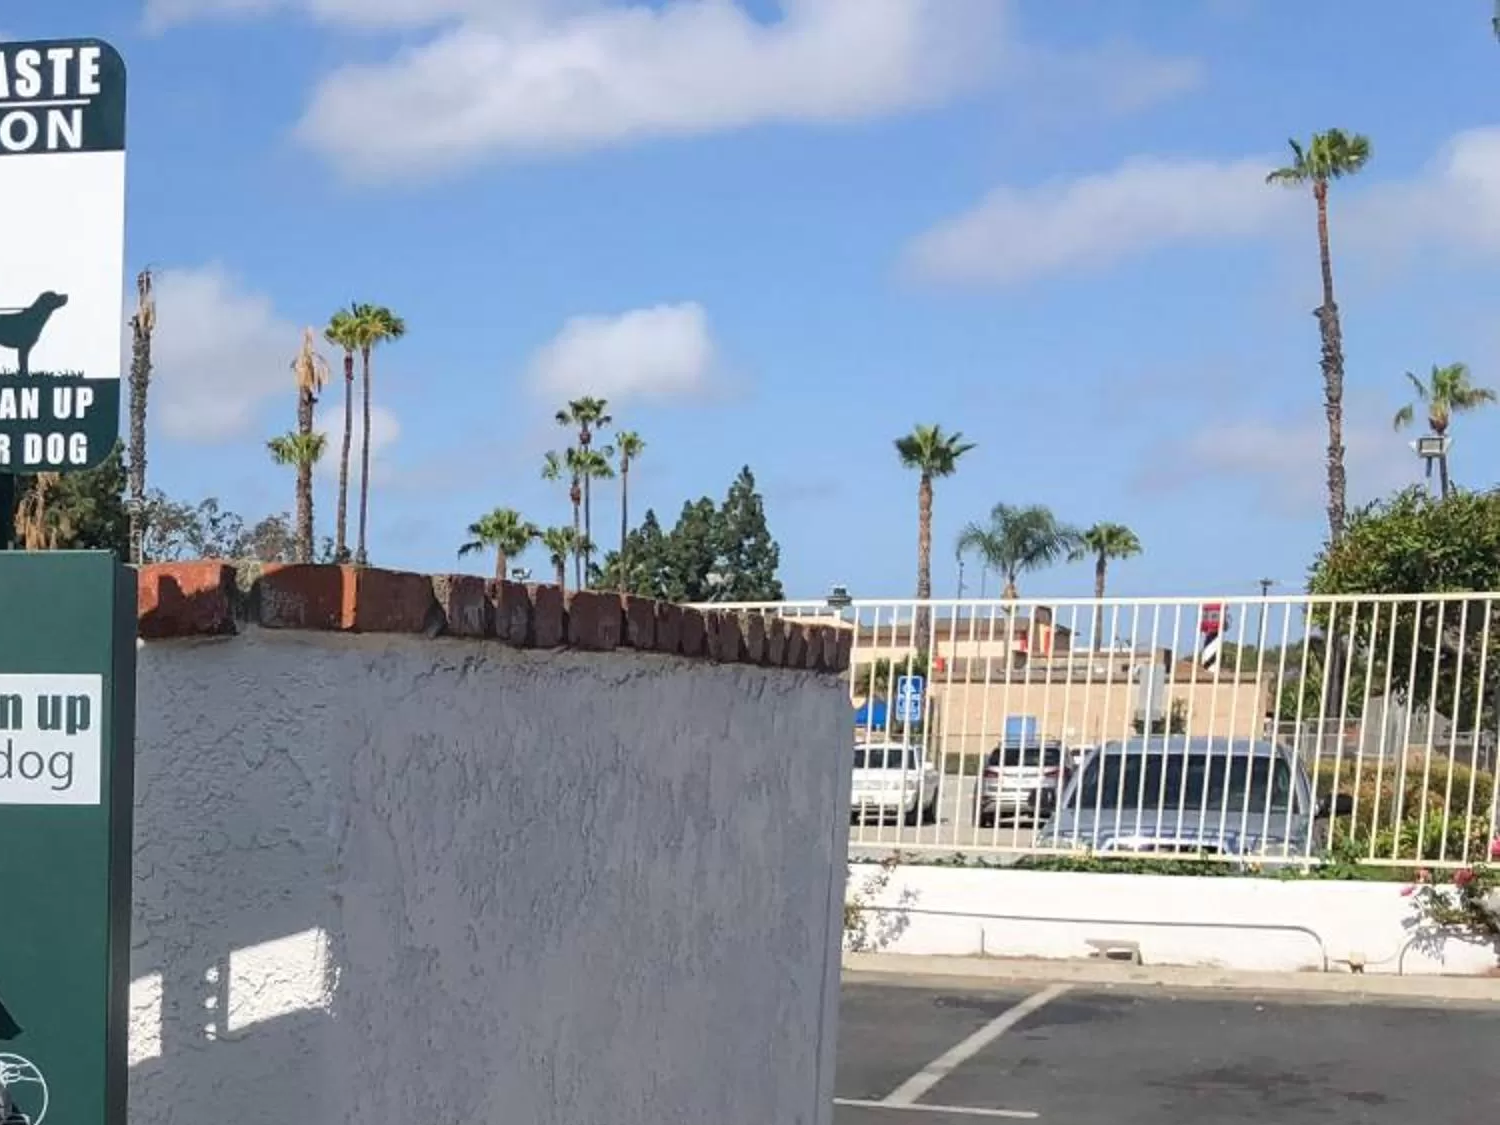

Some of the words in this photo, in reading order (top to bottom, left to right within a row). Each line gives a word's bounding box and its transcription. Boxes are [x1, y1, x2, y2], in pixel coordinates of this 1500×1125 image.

[52, 386, 94, 419] UP
[23, 431, 88, 465] DOG
[36, 692, 91, 735] up
